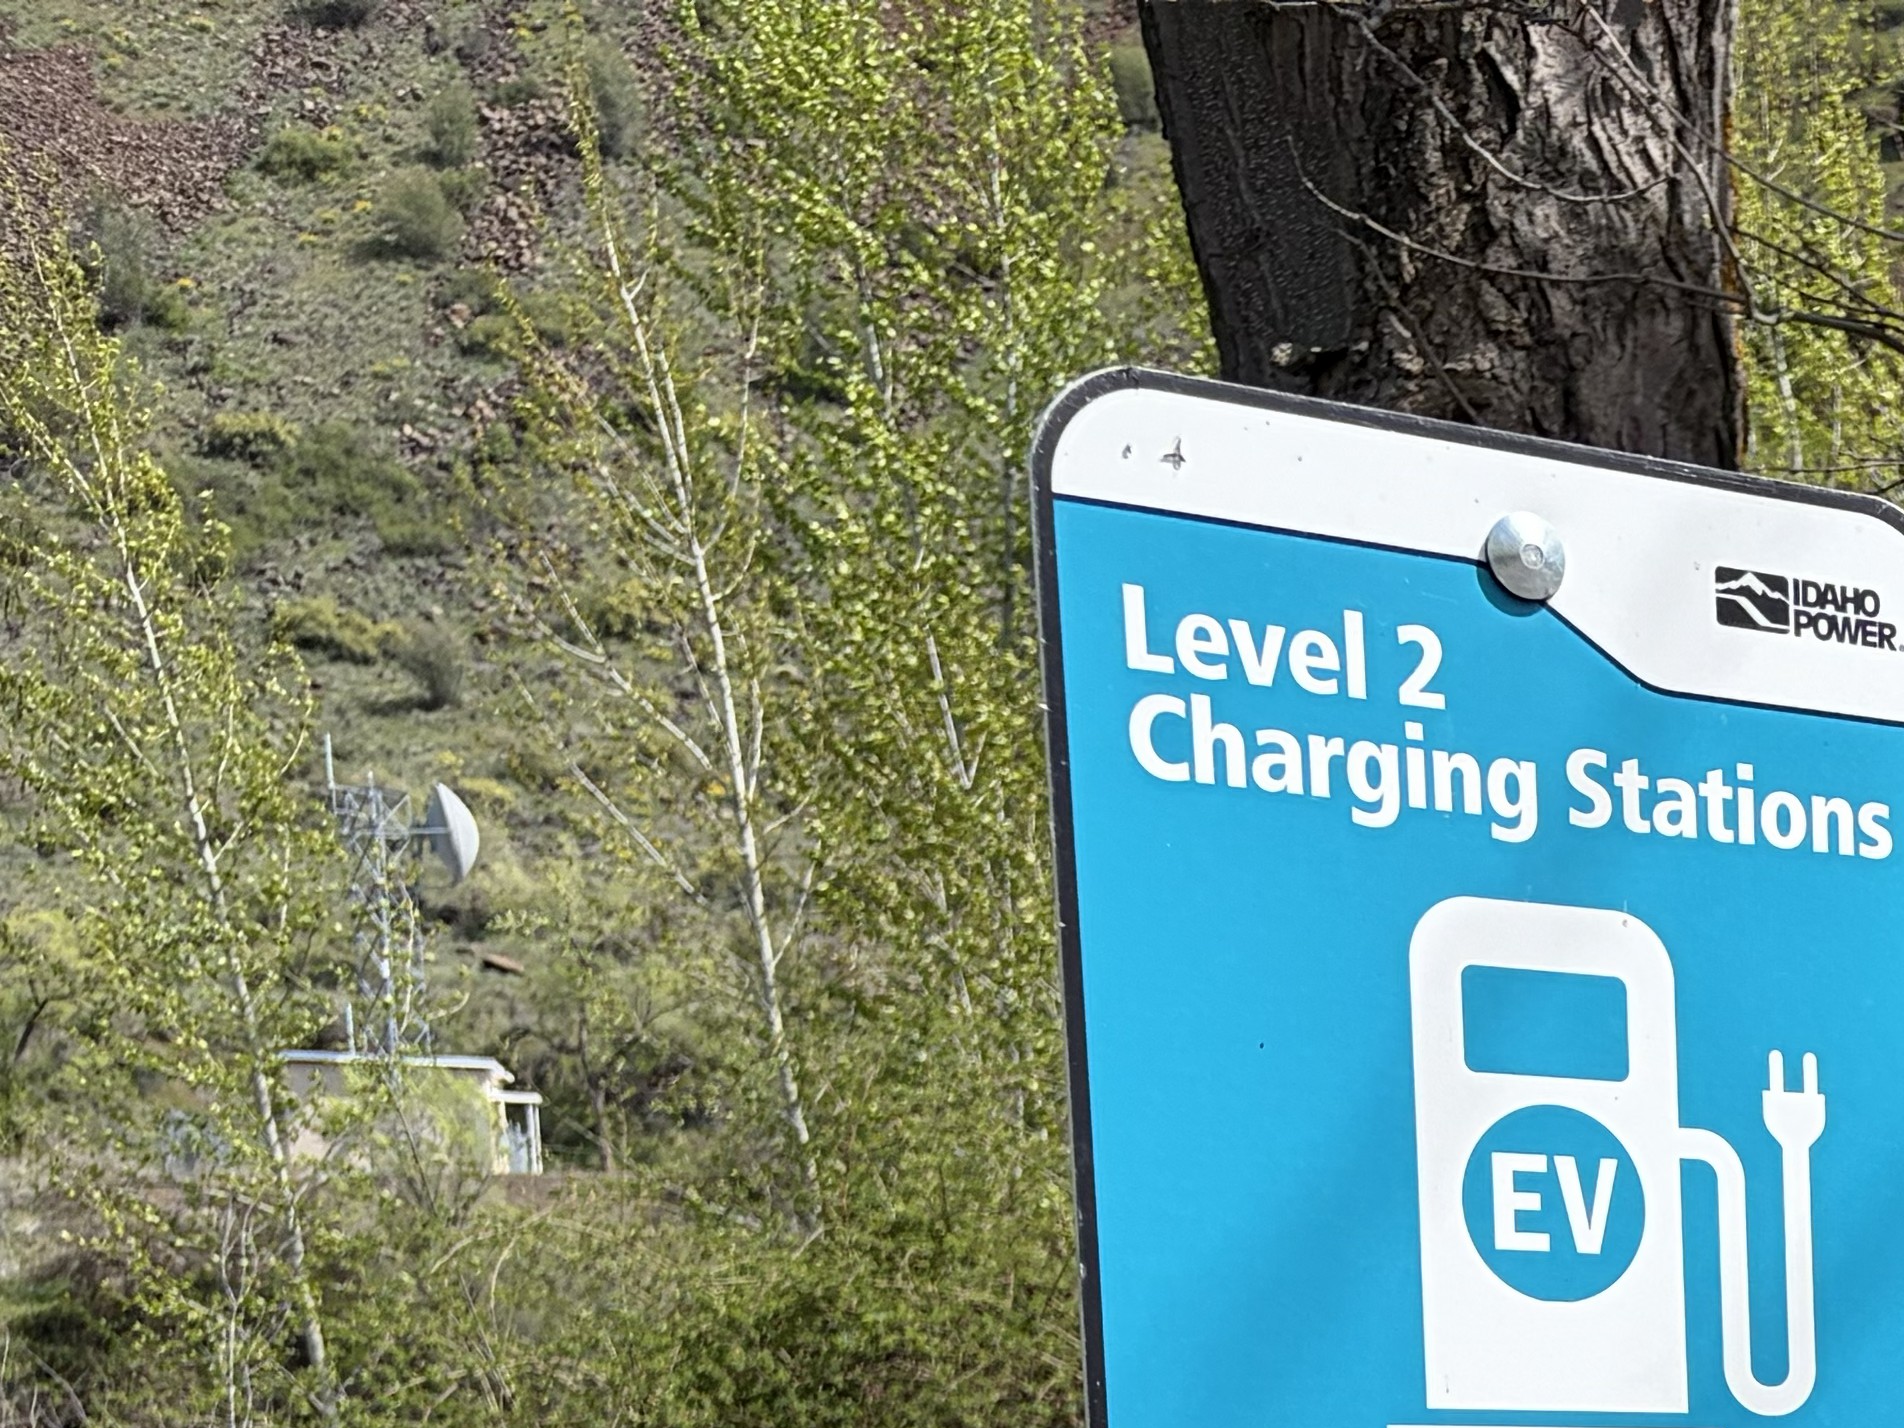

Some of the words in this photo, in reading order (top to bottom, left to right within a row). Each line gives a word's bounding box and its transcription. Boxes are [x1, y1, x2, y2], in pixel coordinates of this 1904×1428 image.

[1123, 584, 1366, 699] Level
[1397, 625, 1445, 709] 2
[1793, 578, 1881, 618] IDAHO
[1129, 694, 1537, 842] Charging
[1566, 749, 1892, 859] Stations
[1492, 1152, 1617, 1254] EV
